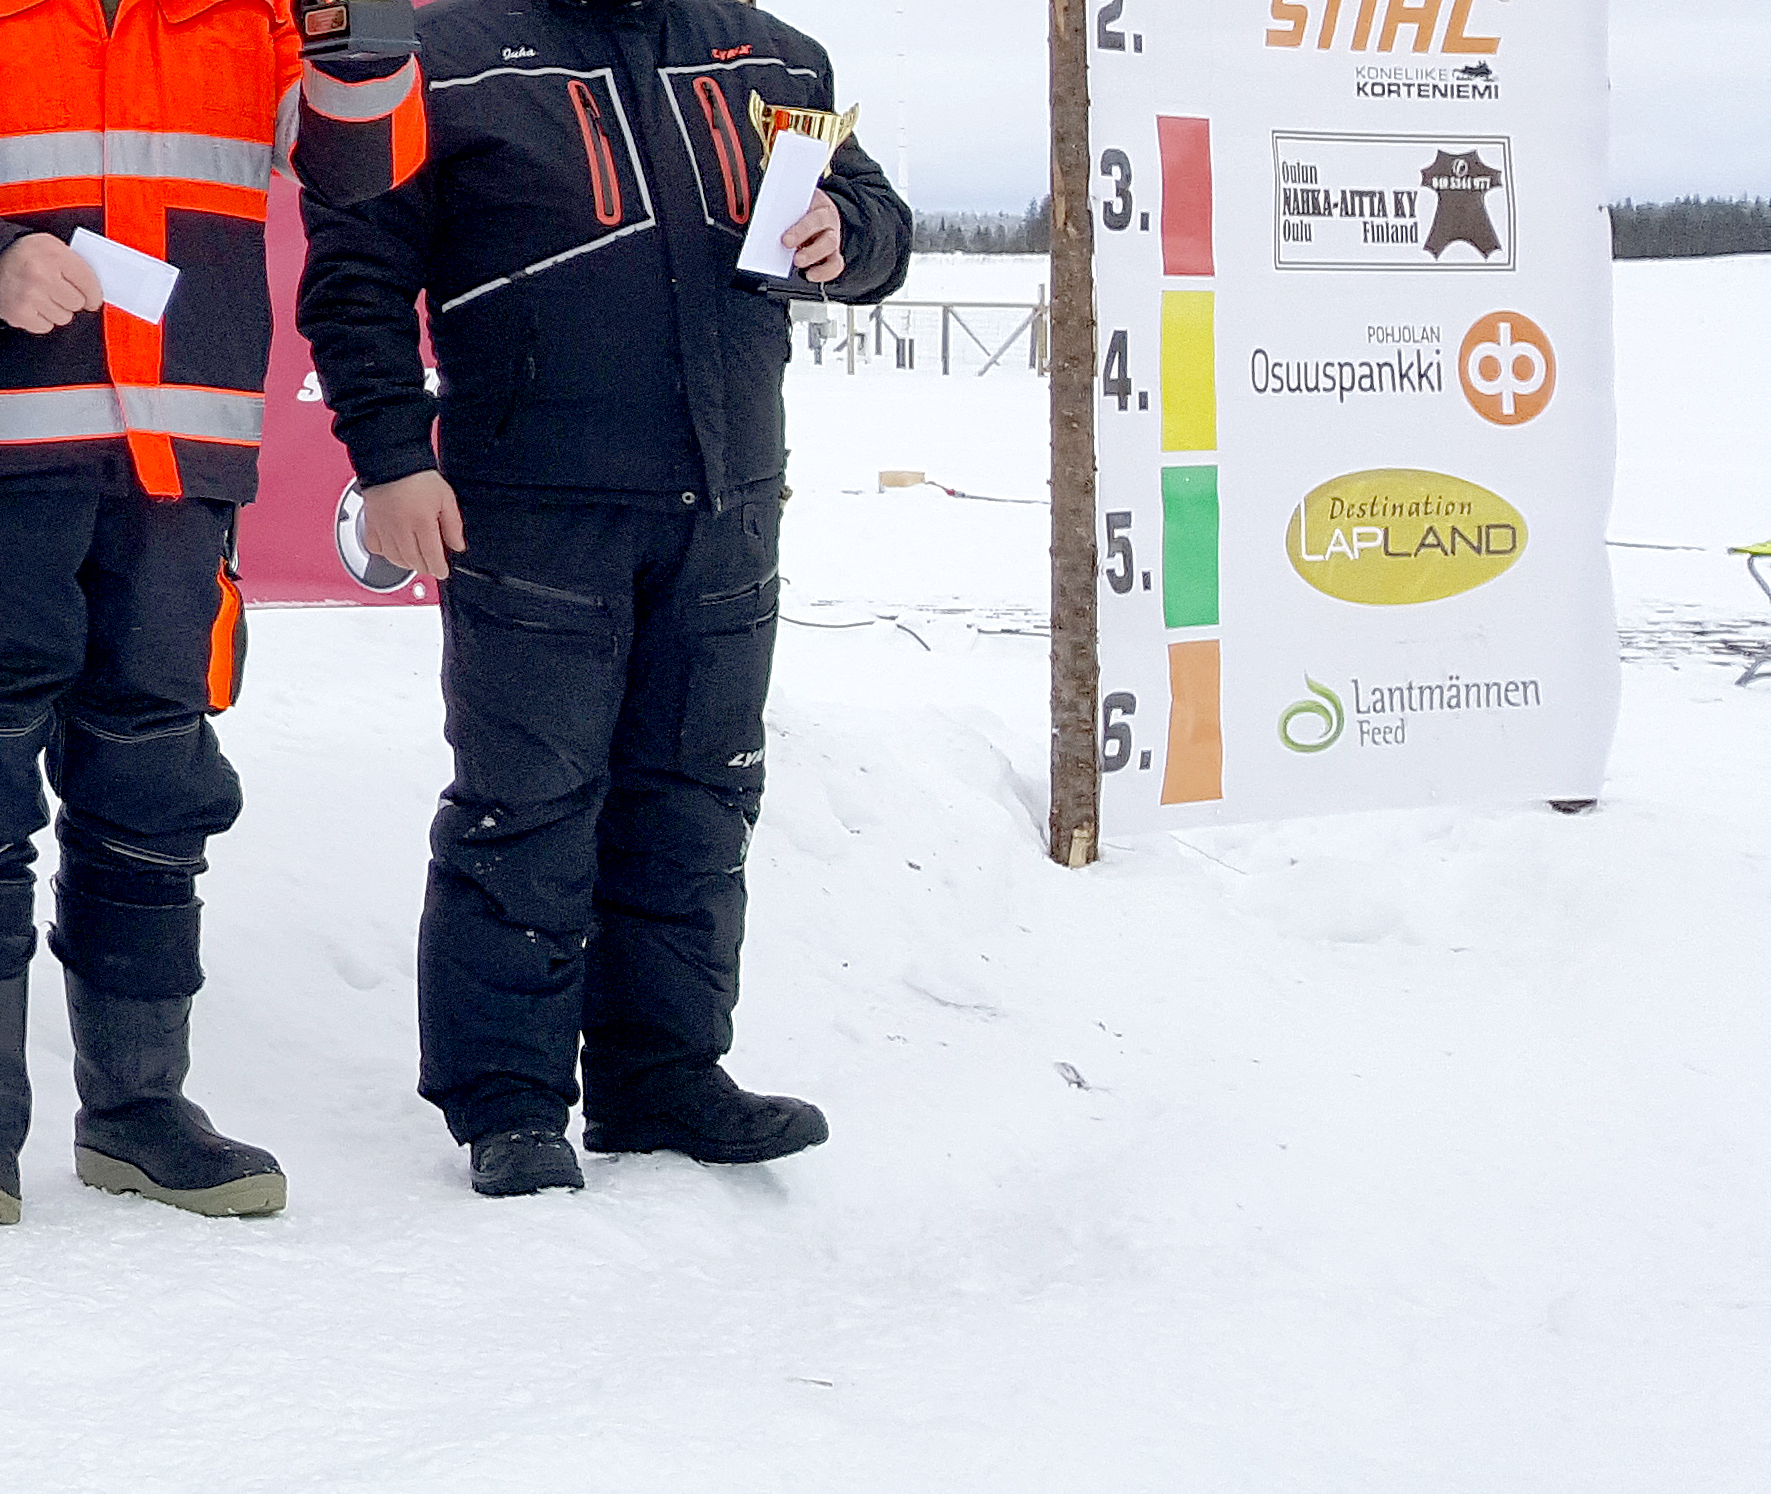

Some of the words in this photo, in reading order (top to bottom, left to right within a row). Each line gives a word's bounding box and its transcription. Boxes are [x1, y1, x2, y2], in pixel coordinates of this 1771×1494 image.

[1355, 66, 1448, 82] KONELIIKE
[1356, 82, 1500, 100] KORTENIEMI
[1281, 161, 1318, 185] Oulun
[1099, 148, 1151, 231] 3.
[1393, 191, 1418, 218] KY
[1282, 219, 1313, 242] Oulu
[1362, 221, 1419, 244] Finland
[1367, 325, 1441, 344] POHJOLAN
[1102, 330, 1149, 411] 4.
[1250, 348, 1443, 403] Osuuspankki
[1329, 494, 1473, 520] Destination
[1105, 511, 1153, 594] 5.
[1351, 677, 1541, 714] Lantmännen
[1101, 692, 1153, 774] 6.
[1358, 719, 1406, 746] Feed
